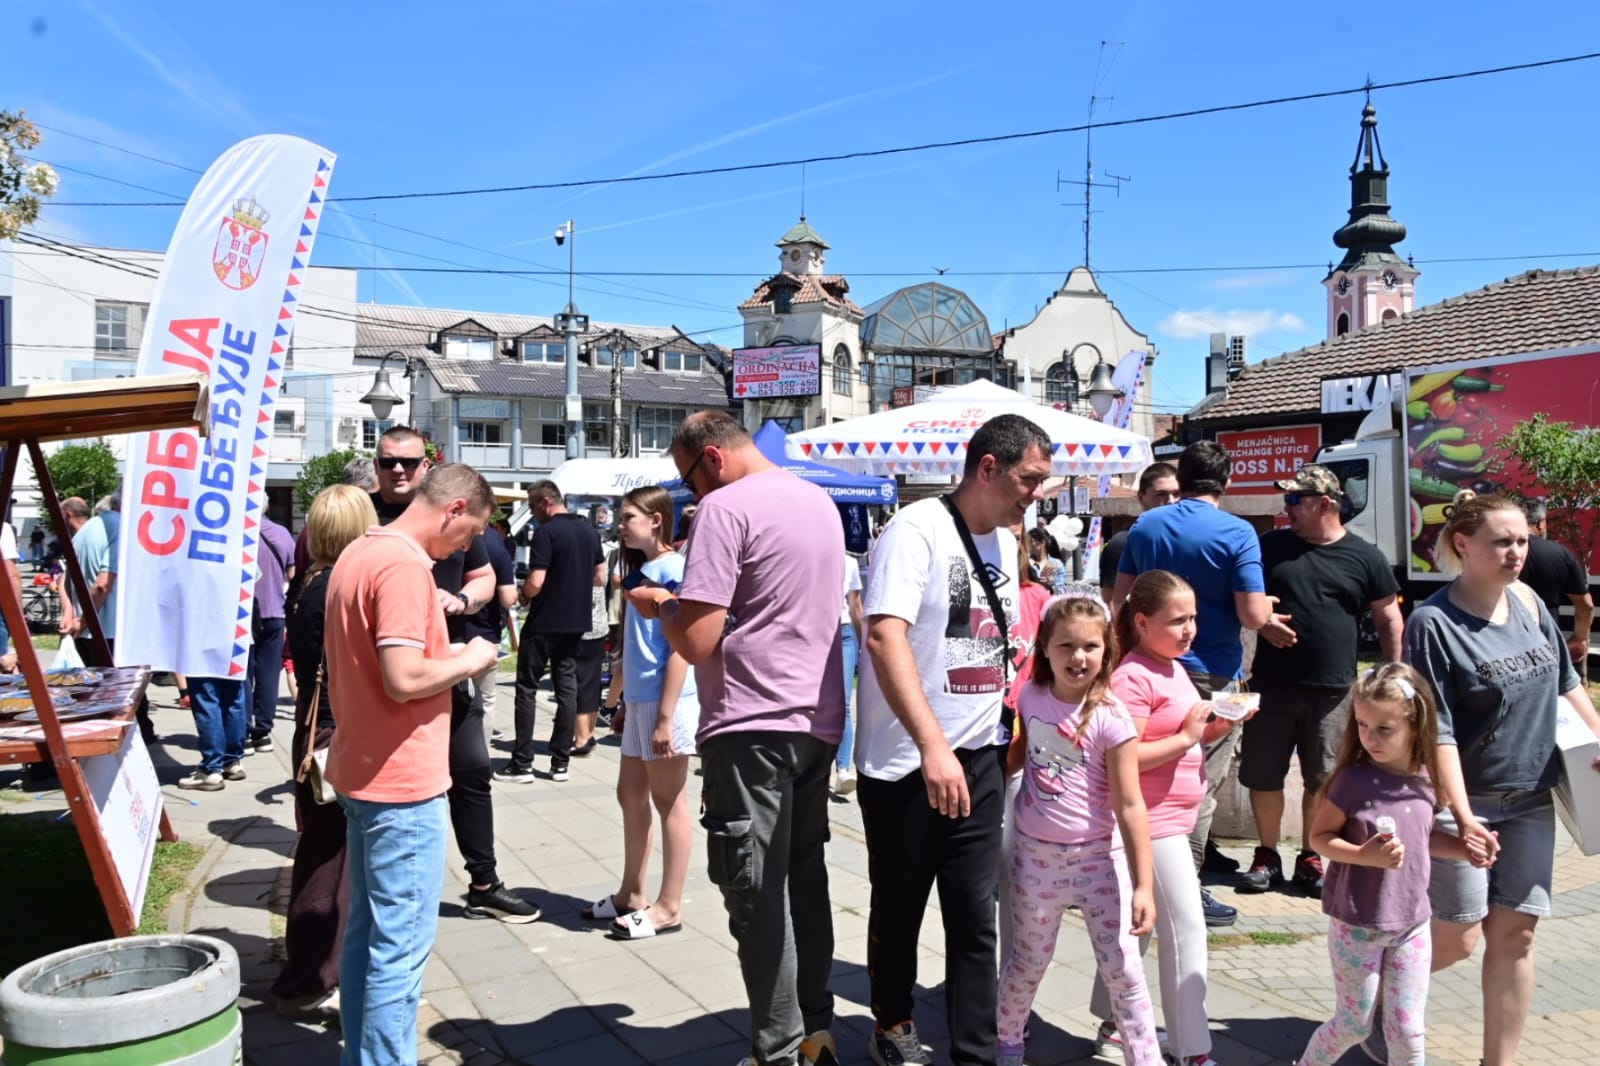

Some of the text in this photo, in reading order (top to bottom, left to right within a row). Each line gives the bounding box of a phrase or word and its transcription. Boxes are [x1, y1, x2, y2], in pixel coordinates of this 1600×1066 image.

[137, 317, 221, 556] СРБЈА
[187, 322, 257, 564] ПОБЕЂУЈЕ
[1237, 435, 1296, 448] MENJAČNICA
[1275, 445, 1310, 455] OFFICE
[977, 595, 1012, 608] umro
